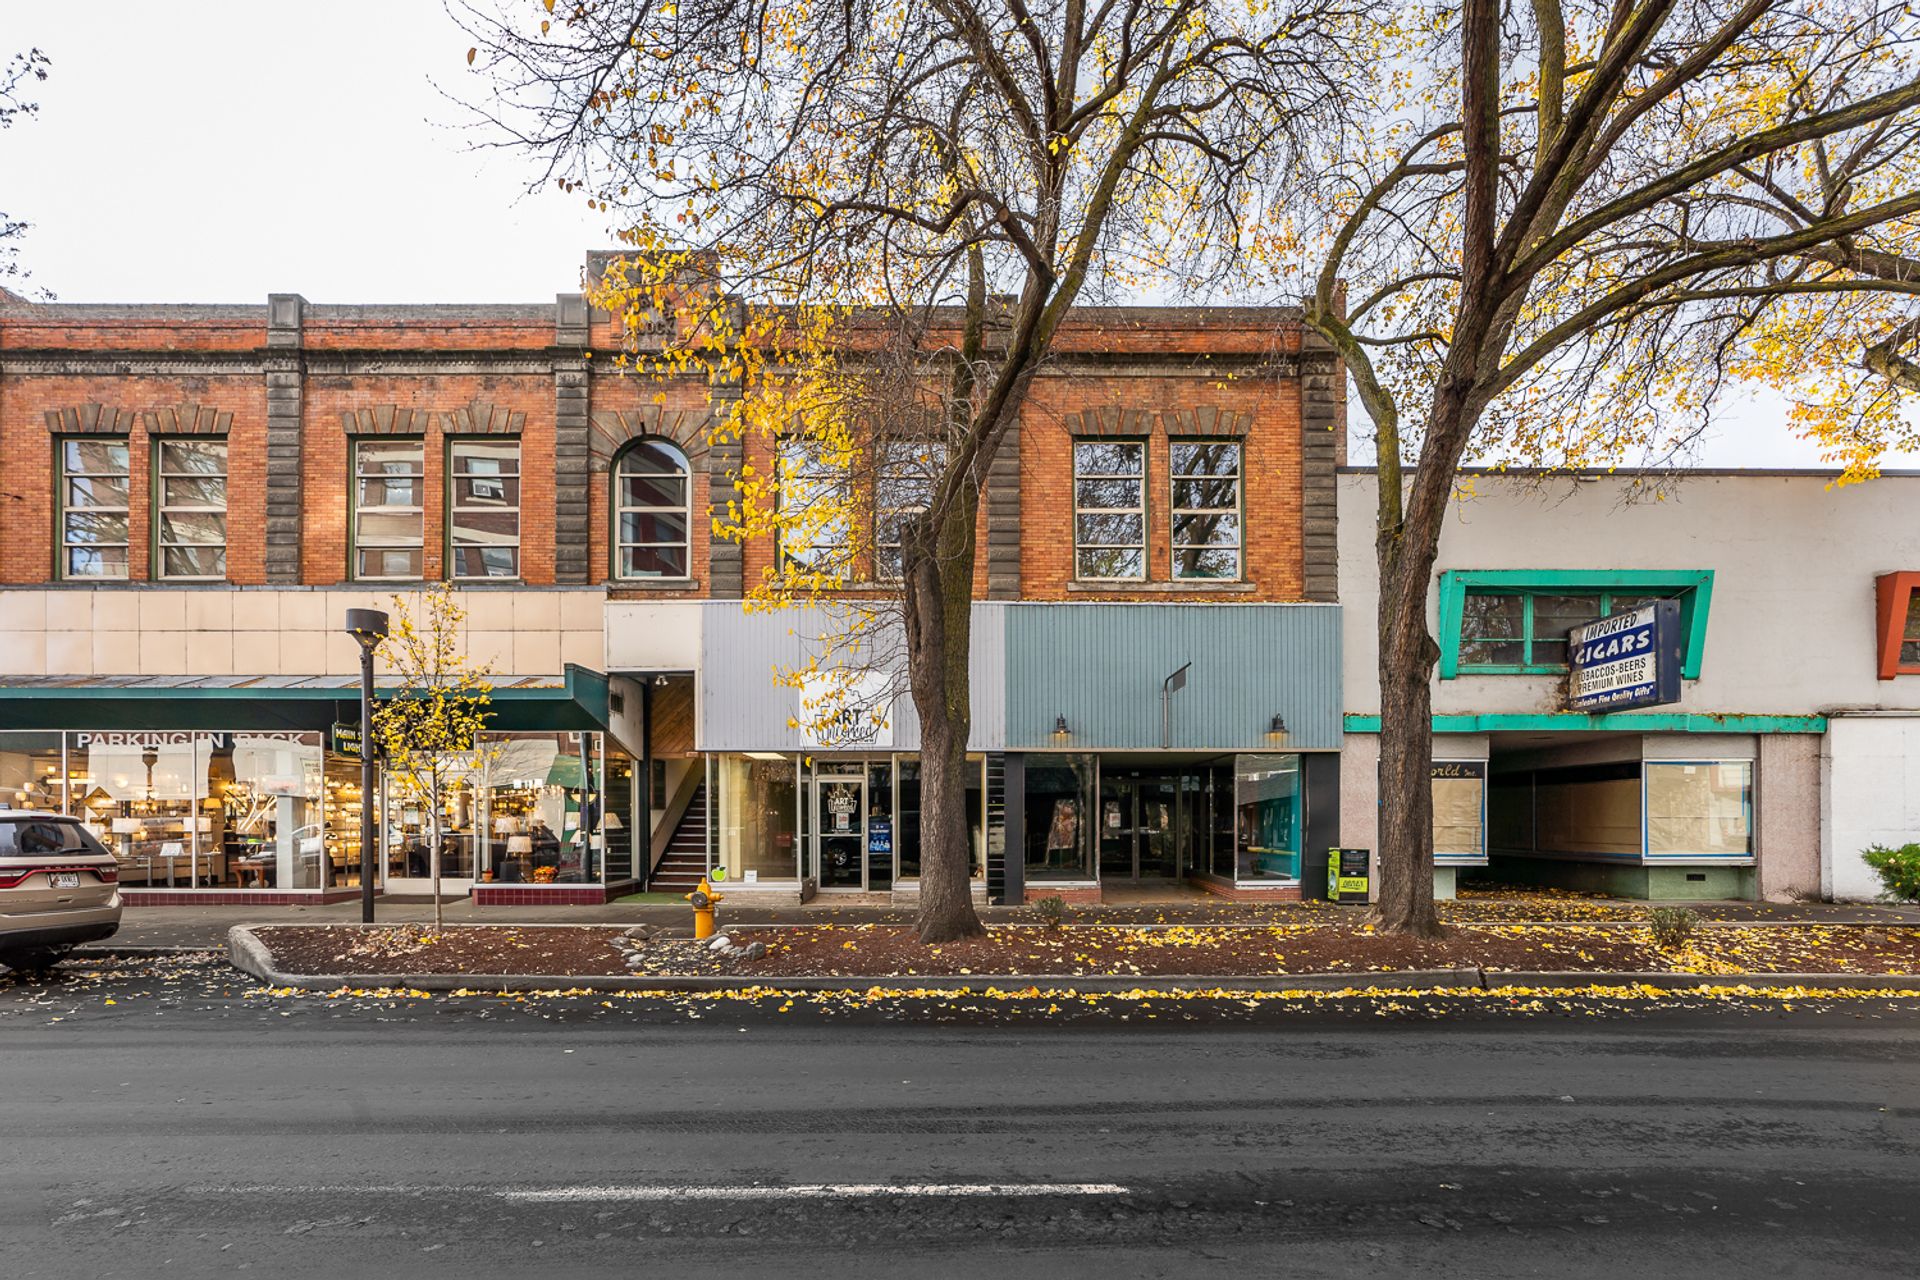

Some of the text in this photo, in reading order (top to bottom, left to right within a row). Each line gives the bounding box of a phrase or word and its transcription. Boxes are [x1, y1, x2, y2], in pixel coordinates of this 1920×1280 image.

[626, 320, 676, 336] LOCK
[1585, 612, 1637, 641] IMPORTED
[1575, 629, 1650, 665] CIGARS
[1577, 670, 1644, 695] PREMIUM WINES
[831, 708, 861, 725] ART
[77, 733, 187, 748] PARKING
[1430, 763, 1460, 776] orld
[834, 797, 849, 805] ART
